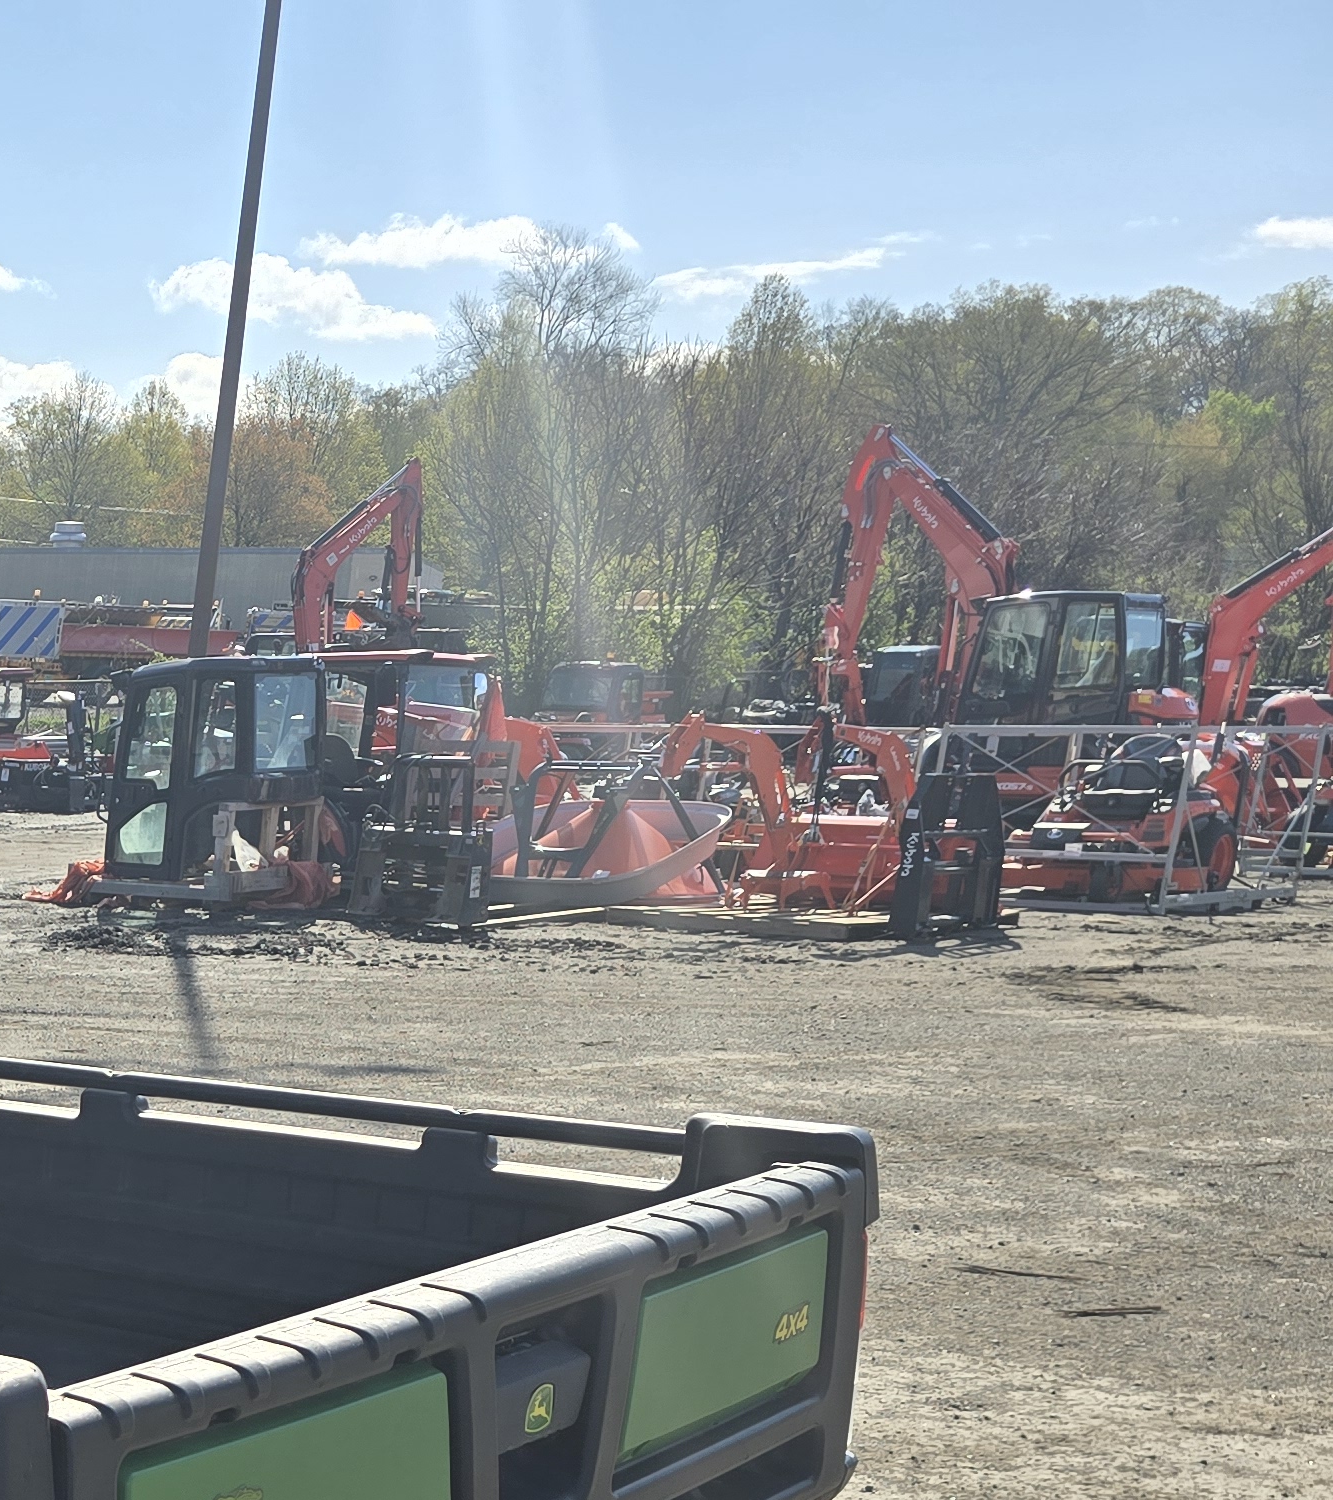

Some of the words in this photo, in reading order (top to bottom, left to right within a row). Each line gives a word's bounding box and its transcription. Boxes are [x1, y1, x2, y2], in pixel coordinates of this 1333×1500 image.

[912, 496, 939, 529] Kubota
[348, 517, 378, 544] Kubota
[1265, 568, 1305, 597] Kubota
[900, 832, 920, 877] Kubota
